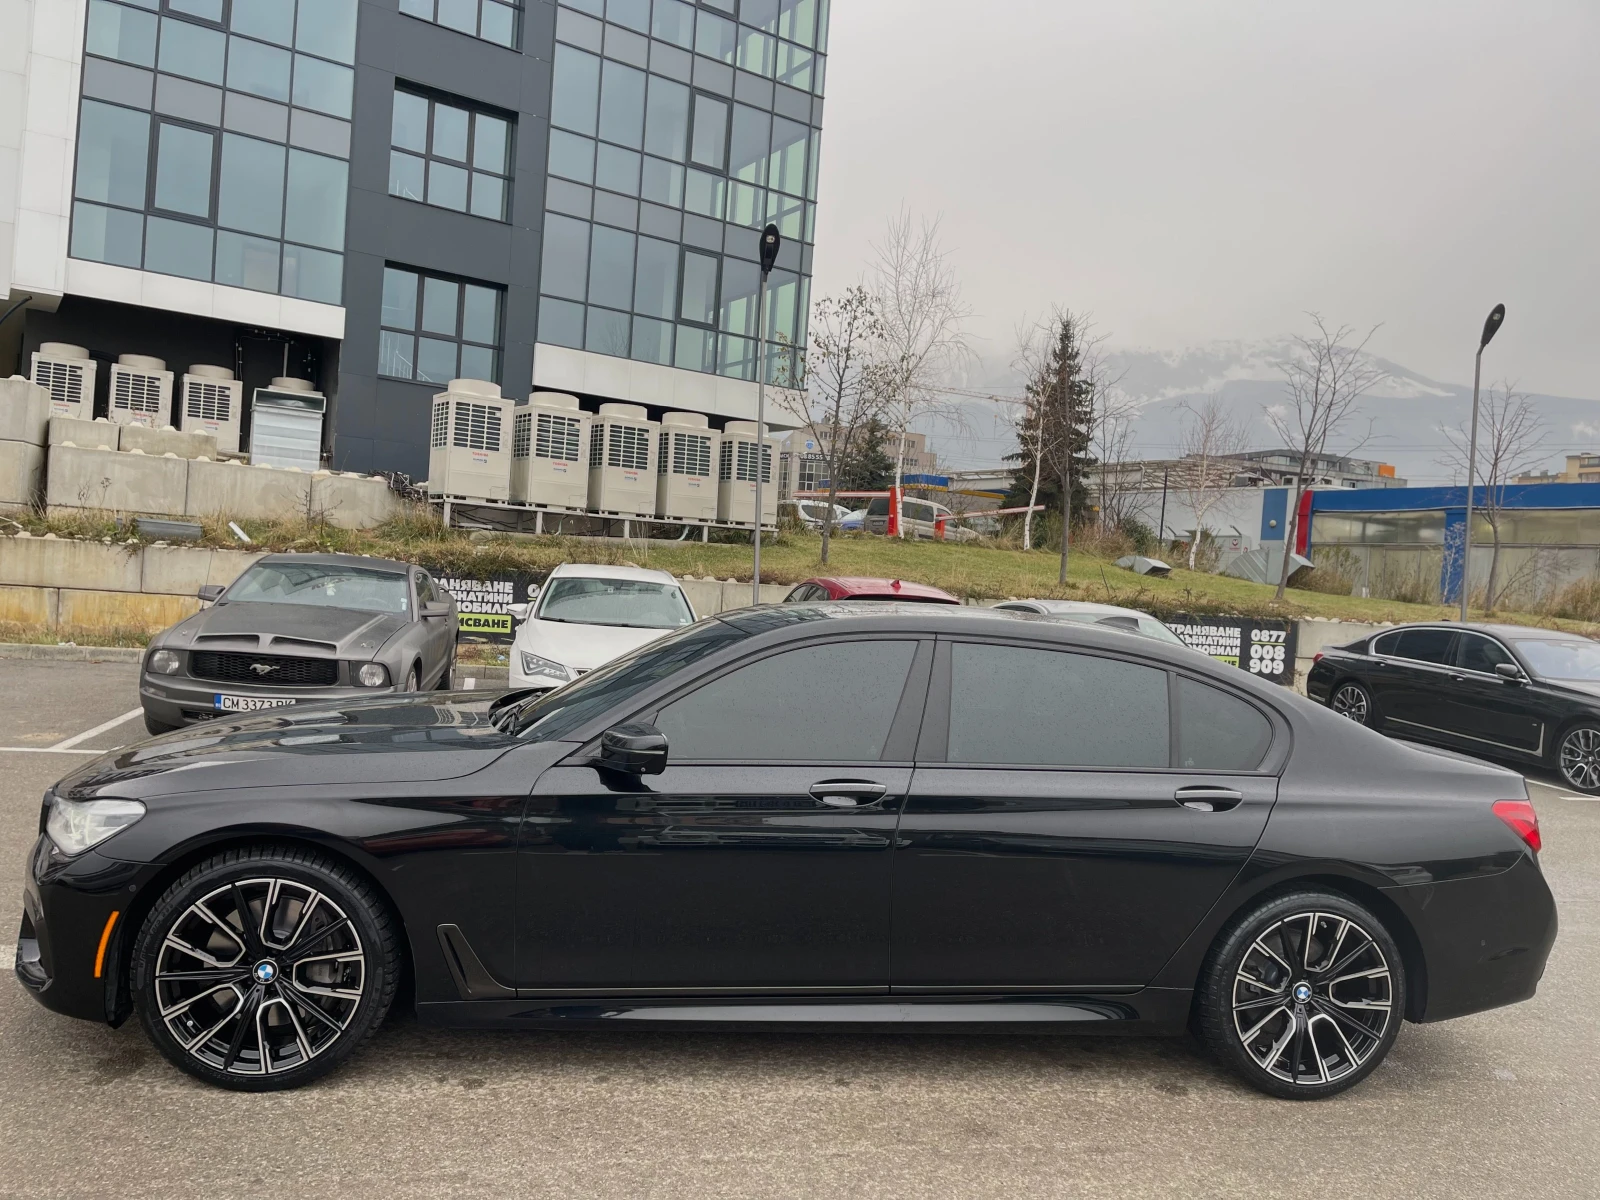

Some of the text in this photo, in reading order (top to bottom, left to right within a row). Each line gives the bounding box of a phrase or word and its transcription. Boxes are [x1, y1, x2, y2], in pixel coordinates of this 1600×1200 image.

[1250, 629, 1287, 643] 0877
[1250, 644, 1286, 660] 008
[1249, 658, 1285, 674] 909
[223, 697, 240, 710] CM
